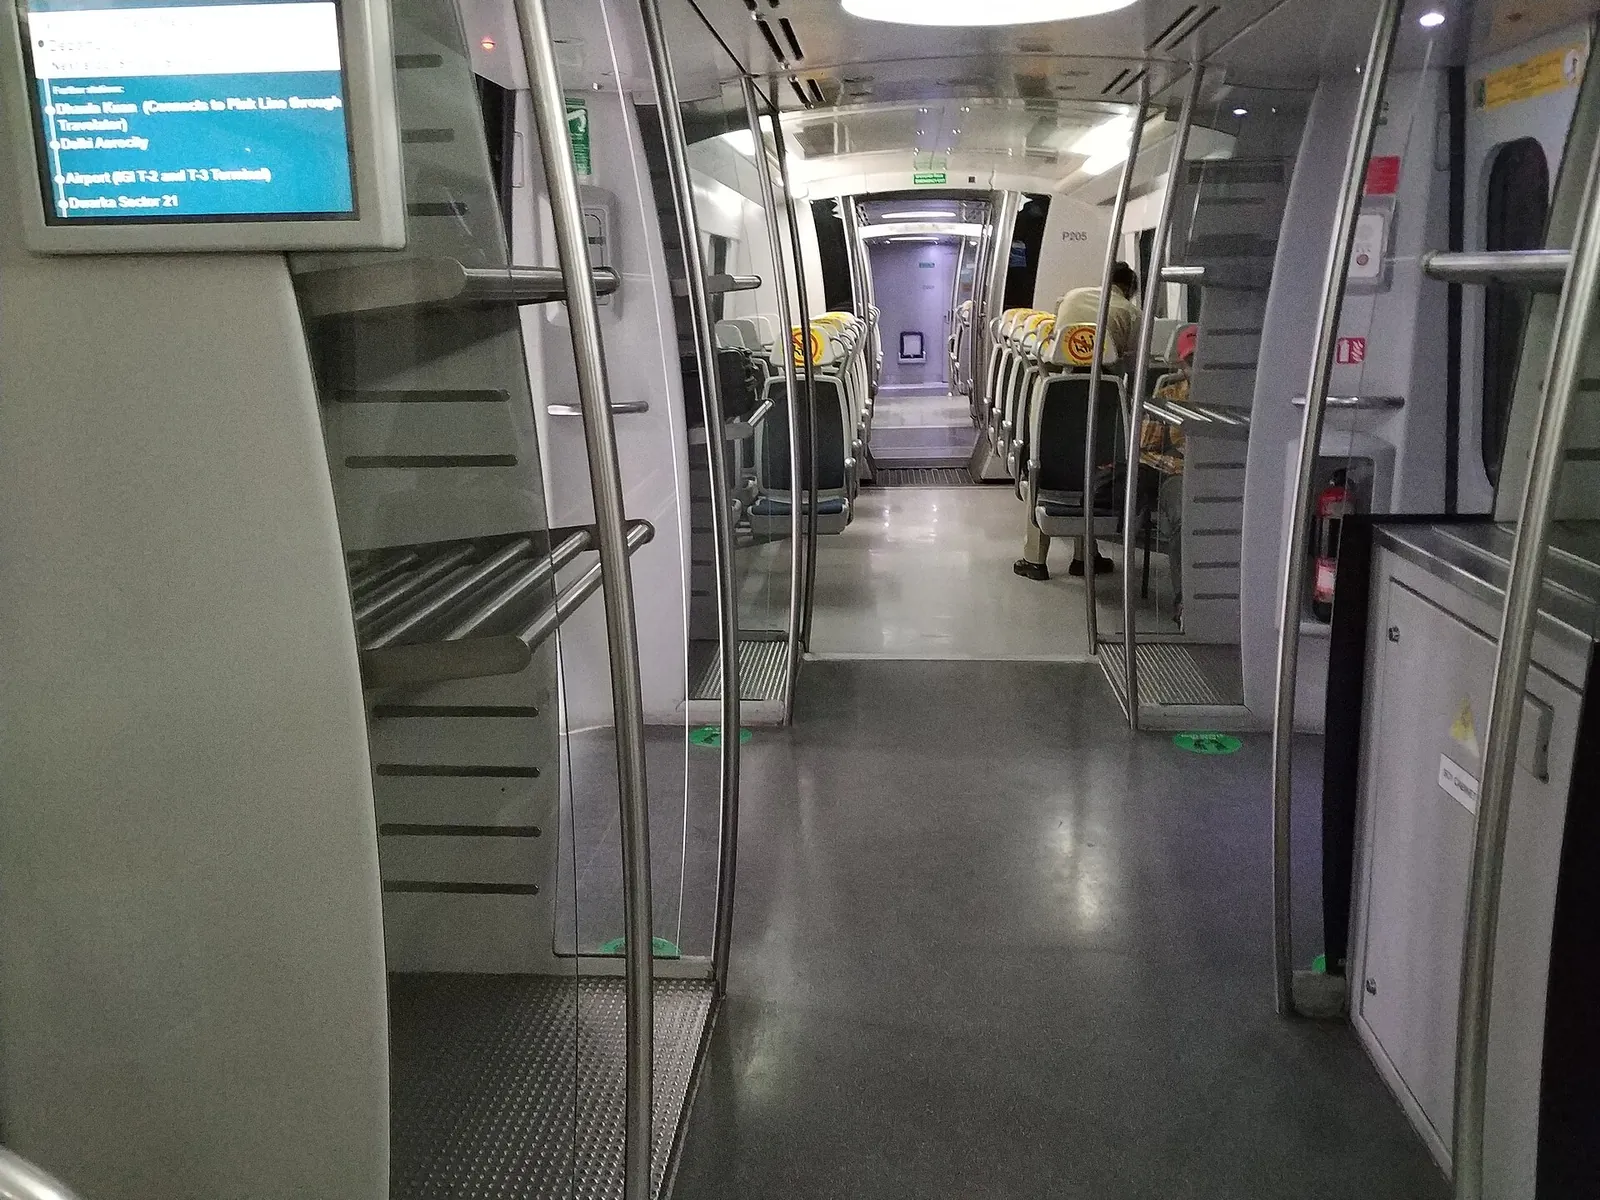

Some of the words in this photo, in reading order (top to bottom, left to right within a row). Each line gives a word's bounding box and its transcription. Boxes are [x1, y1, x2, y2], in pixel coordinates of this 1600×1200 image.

[258, 96, 287, 109] Line
[66, 172, 112, 187] Airport
[136, 170, 160, 182] T-2
[161, 169, 186, 182] and
[186, 168, 209, 181] T-3
[161, 194, 179, 207] 21
[1062, 231, 1088, 241] P205
